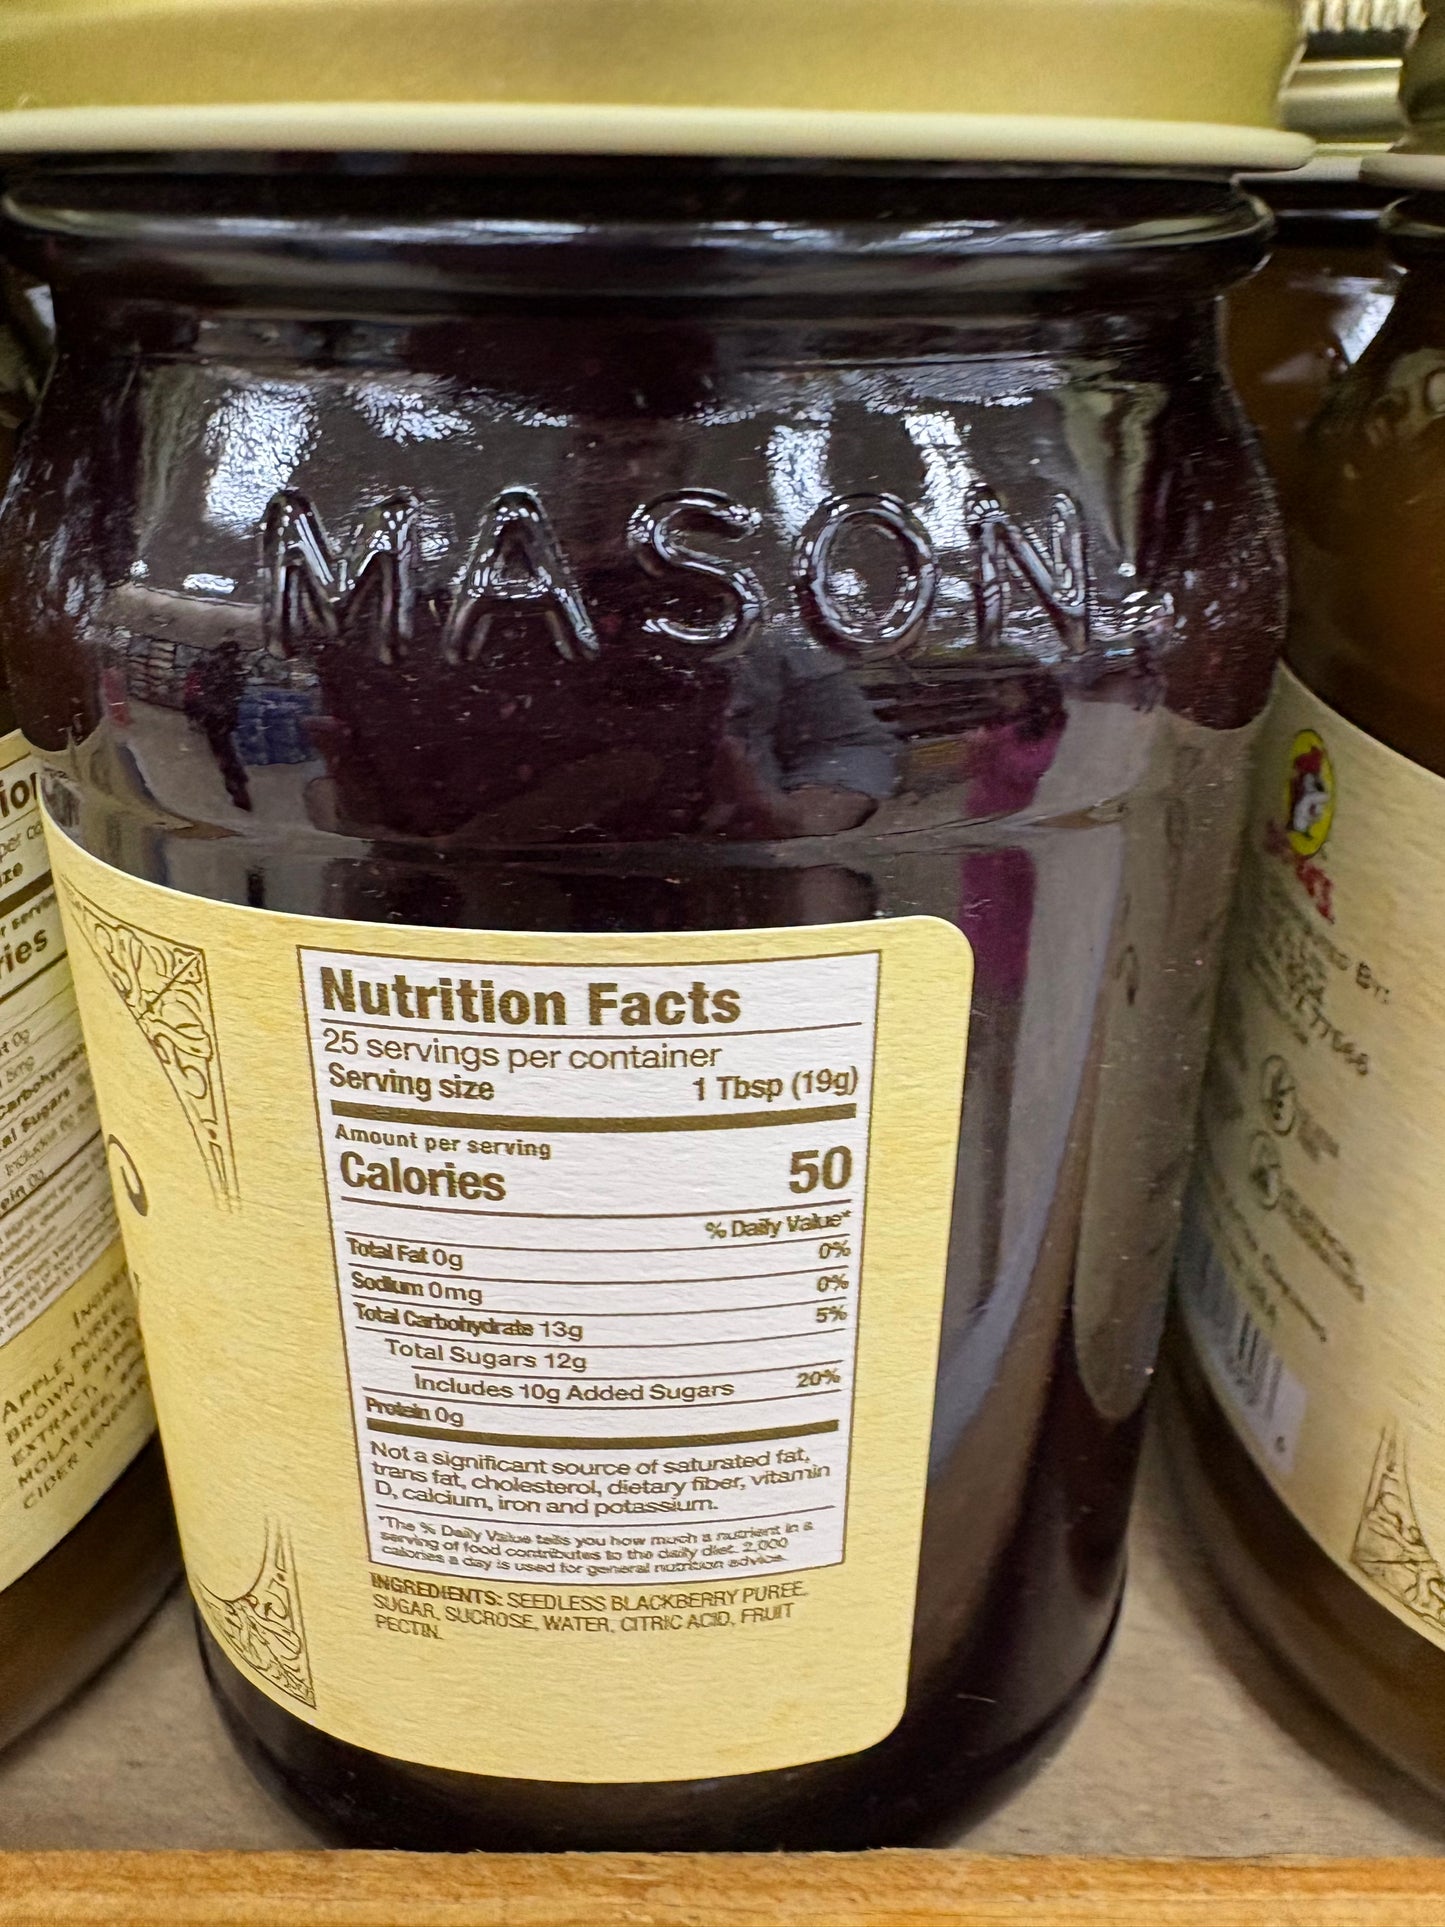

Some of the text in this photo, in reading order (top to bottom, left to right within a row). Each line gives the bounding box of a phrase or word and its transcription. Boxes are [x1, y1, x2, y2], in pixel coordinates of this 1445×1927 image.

[260, 484, 1089, 663] MASON
[319, 967, 741, 1026] Nutrition Facts
[324, 1027, 722, 1074] 25 servings per container
[328, 1063, 858, 1102] Serving size 1 Tbsp (19g)
[335, 1124, 551, 1160] Amount per serving
[340, 1146, 852, 1201] Calories 50
[731, 1219, 782, 1238] Daily
[347, 1237, 850, 1270] Total Fat 0g 0%
[352, 1271, 849, 1305] Sodium 0mg 0%
[353, 1302, 847, 1341] Total Carbohydrate 13g 5%
[385, 1338, 587, 1372] Total Sugars 12g
[415, 1368, 841, 1403] Includes 10g Added Sugars 20%
[365, 1396, 463, 1426] Protein 0g
[370, 1440, 810, 1475] Not a significant source of saturated fat,
[371, 1460, 830, 1497] trans fat, cholesterol, dietary fiber, vitamin
[375, 1480, 718, 1517] D, calcium, iron and potassium.
[380, 1531, 439, 1550] serving
[443, 1541, 460, 1550] of
[464, 1542, 501, 1555] food
[506, 1545, 601, 1560] contributes
[606, 1550, 622, 1560] to
[627, 1549, 652, 1560] the
[657, 1547, 698, 1563] daily
[441, 1524, 482, 1542] Daily
[486, 1529, 531, 1545] Value
[536, 1534, 571, 1545] tells
[575, 1537, 606, 1548] you
[610, 1535, 645, 1546] how
[651, 1533, 697, 1544] much
[702, 1533, 712, 1542] a
[716, 1527, 780, 1541] nutrient
[785, 1523, 799, 1533] in
[382, 1545, 445, 1564] calories
[463, 1557, 492, 1571] day
[497, 1559, 510, 1570] is
[514, 1562, 554, 1573] used
[559, 1562, 582, 1573] for
[586, 1562, 649, 1577] general
[654, 1560, 724, 1573] nutrition
[507, 1592, 606, 1611] SEEDLESS
[611, 1588, 740, 1611] BLACKBERRY
[621, 1616, 683, 1633] CITRIC
[741, 1603, 795, 1624] FRUIT
